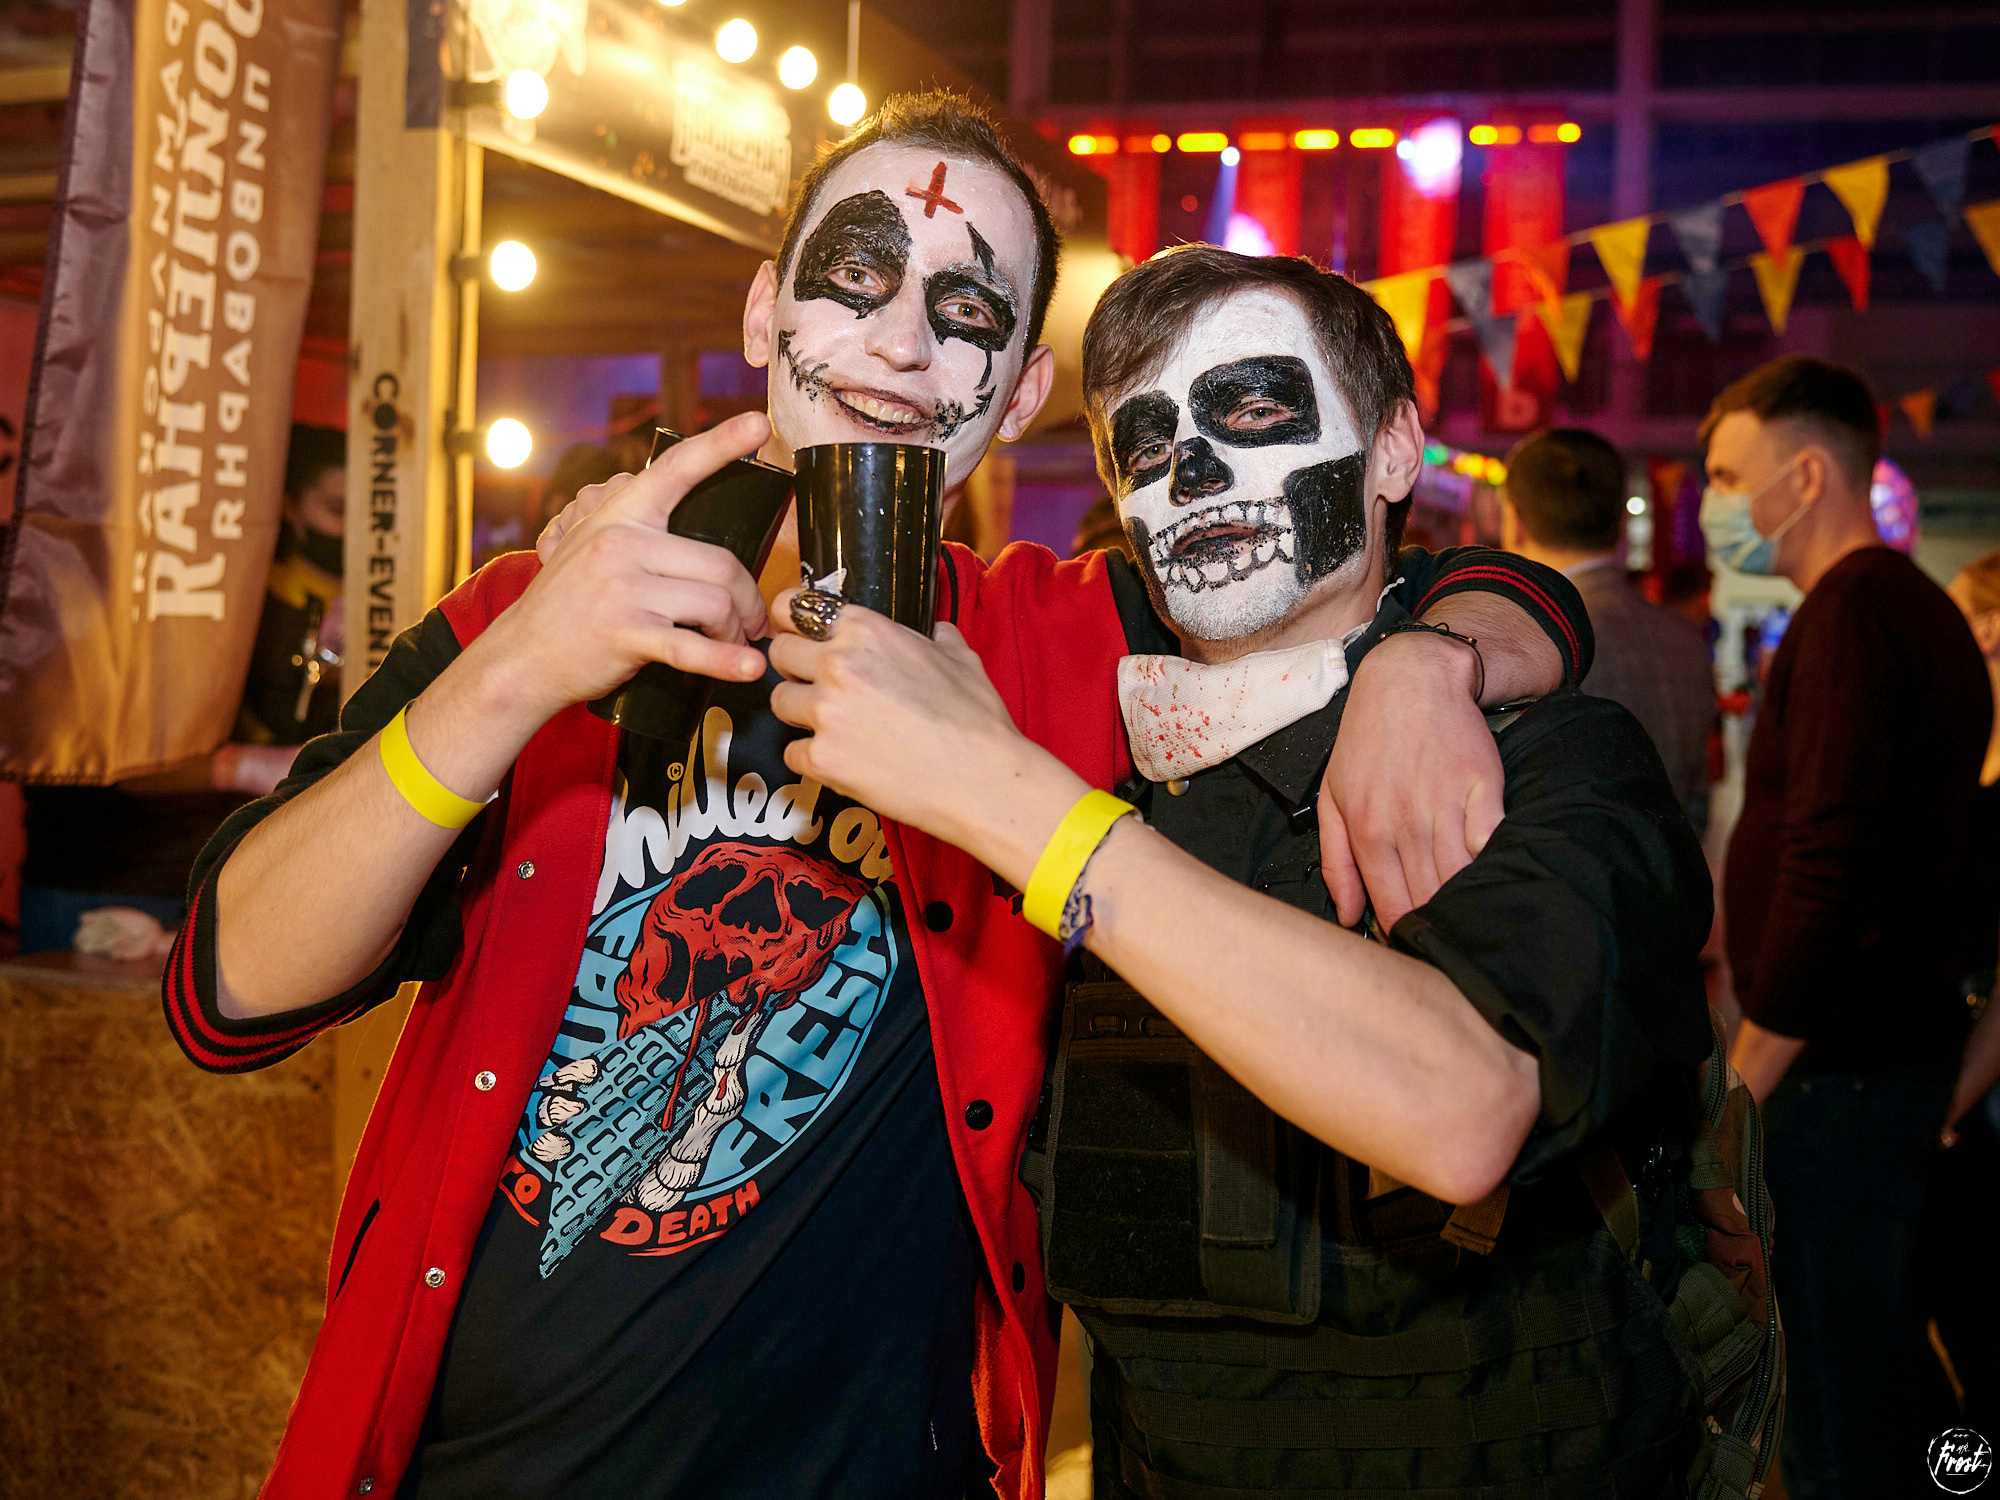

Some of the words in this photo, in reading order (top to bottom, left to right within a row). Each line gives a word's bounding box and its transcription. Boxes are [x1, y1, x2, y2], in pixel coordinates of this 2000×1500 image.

[590, 706, 824, 916] hilled
[698, 895, 888, 1187] FRESH
[600, 1179, 761, 1246] DEATH
